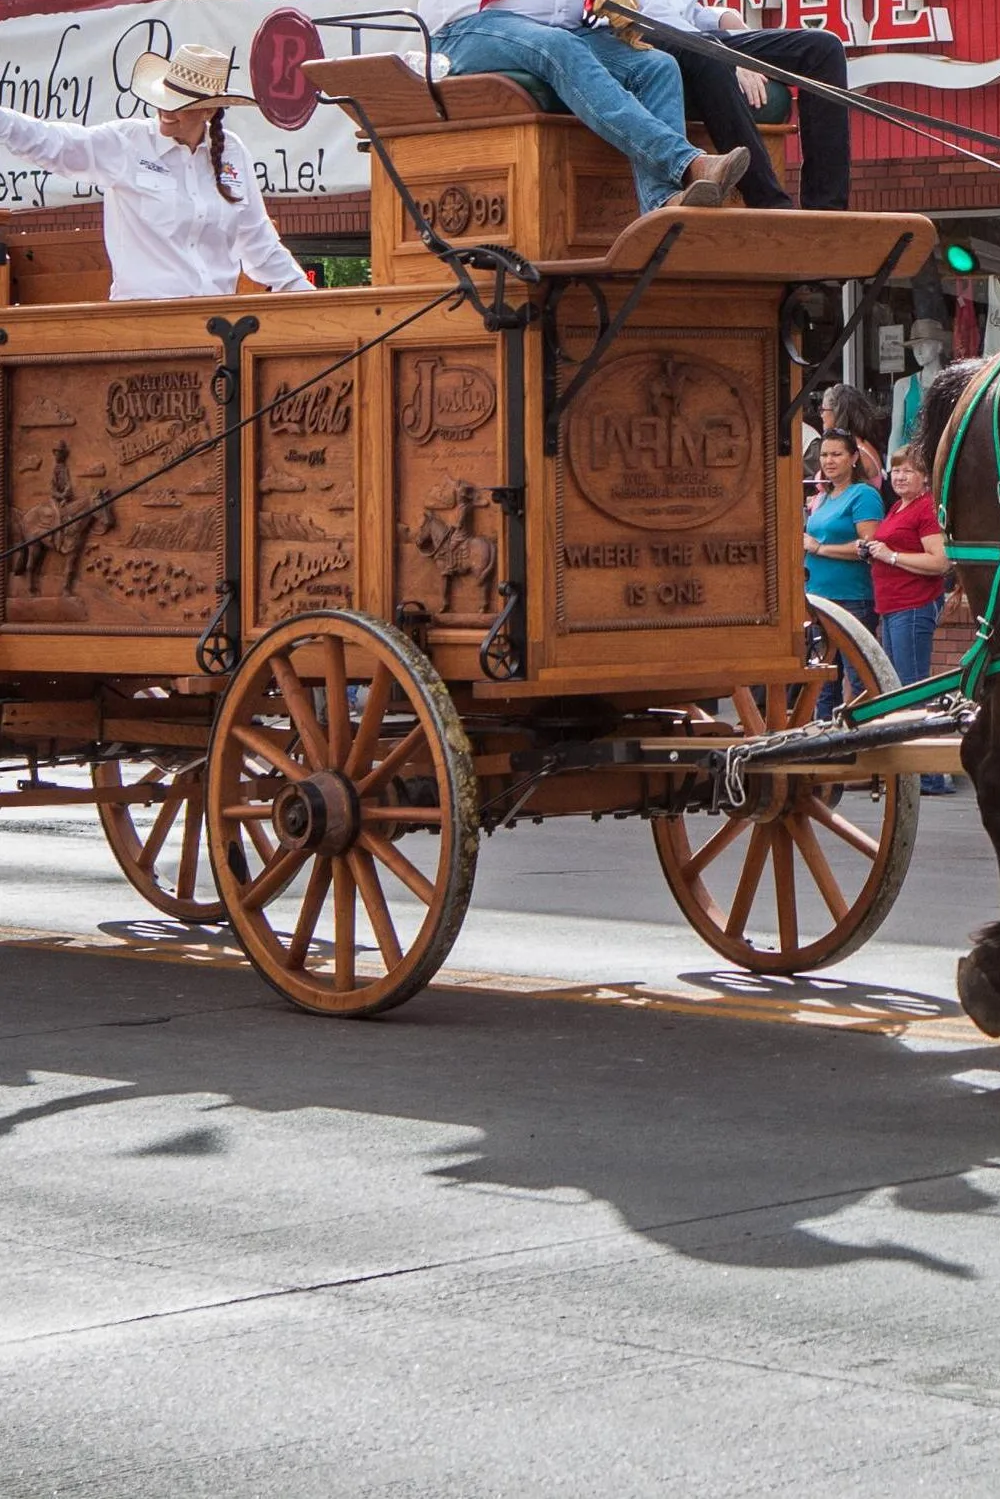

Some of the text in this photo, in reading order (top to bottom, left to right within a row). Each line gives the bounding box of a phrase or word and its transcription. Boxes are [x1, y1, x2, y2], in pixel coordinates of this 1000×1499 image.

[113, 19, 241, 118] Bt
[253, 148, 326, 193] ale!
[473, 194, 503, 225] 96
[125, 371, 202, 393] NATIONAL
[563, 540, 765, 569] WHERE THE WEST
[626, 580, 706, 606] IS ONE
